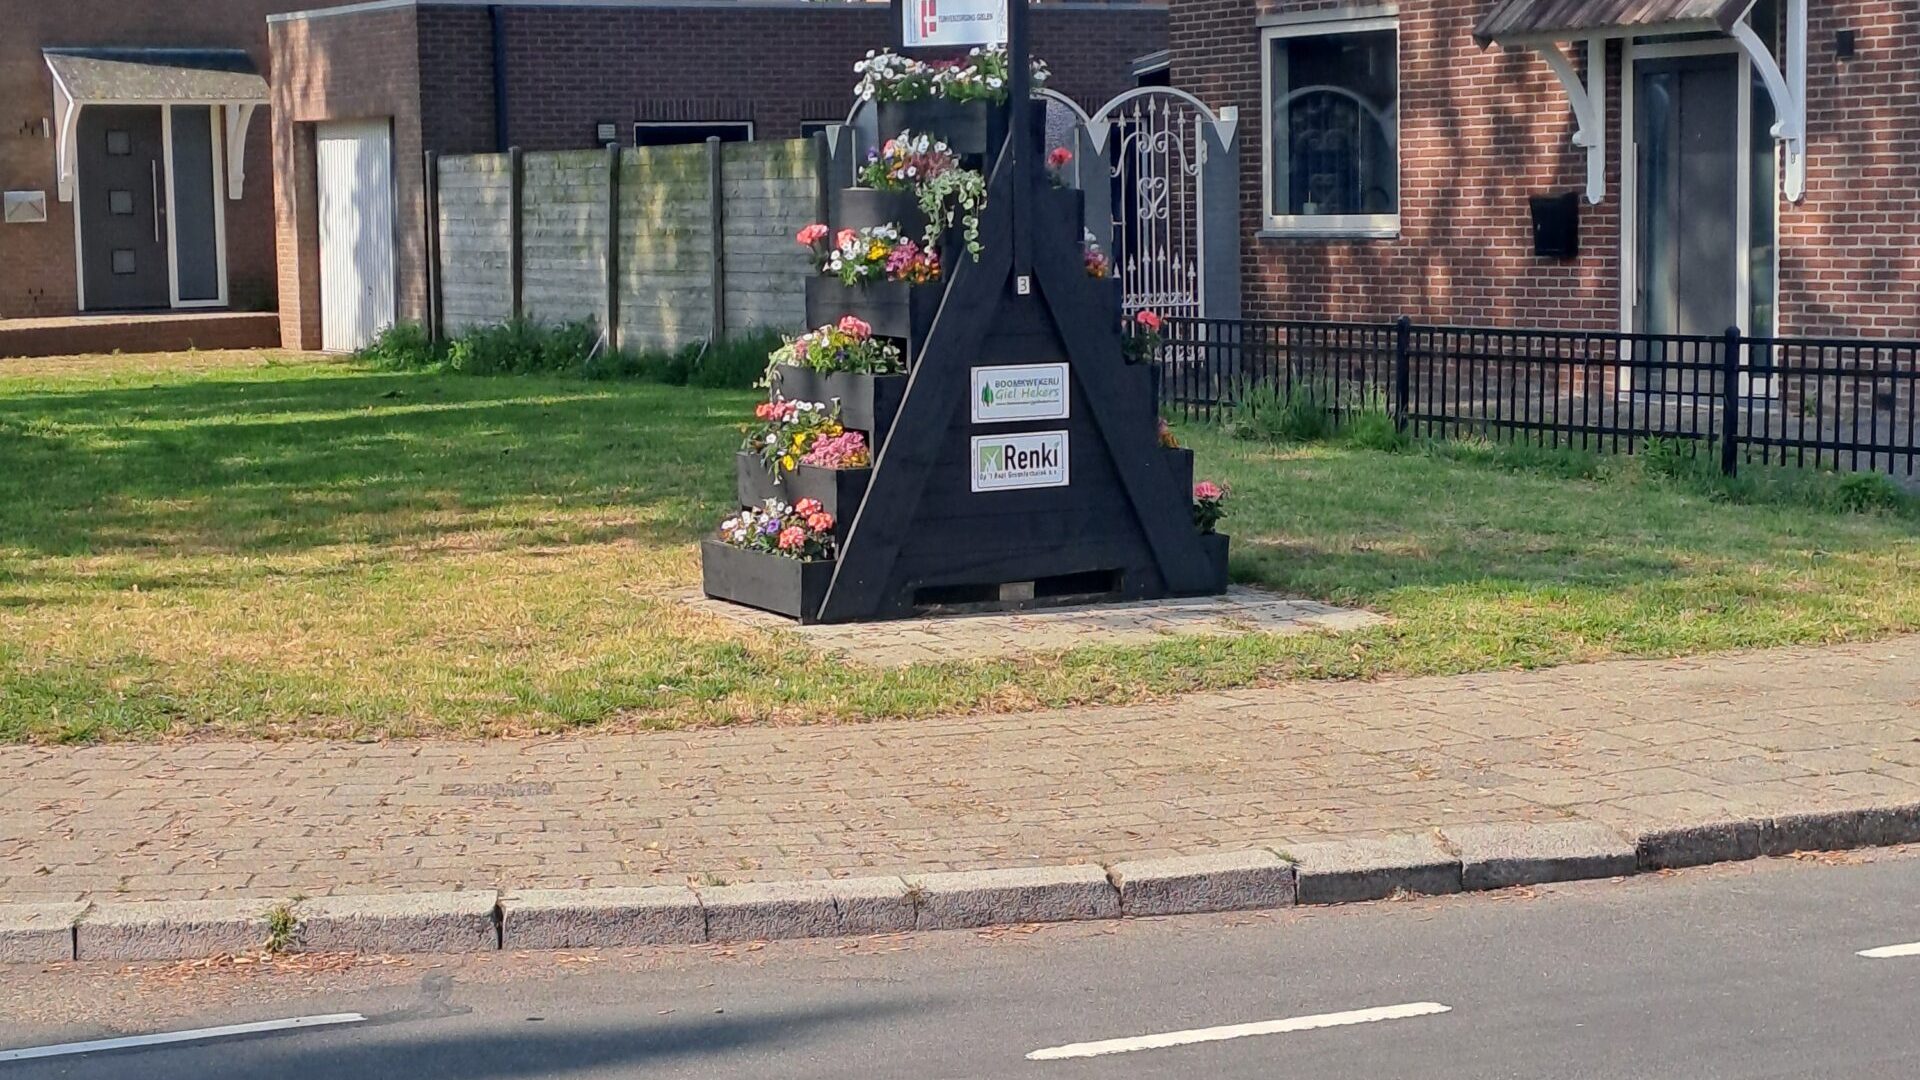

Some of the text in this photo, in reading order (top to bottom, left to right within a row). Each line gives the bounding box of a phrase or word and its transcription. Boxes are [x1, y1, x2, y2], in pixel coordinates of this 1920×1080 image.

[1020, 278, 1027, 292] 3
[995, 377, 1060, 388] BOOMKWEKERIJ
[995, 387, 1059, 401] Giel Hekers
[1004, 441, 1060, 471] Renki
